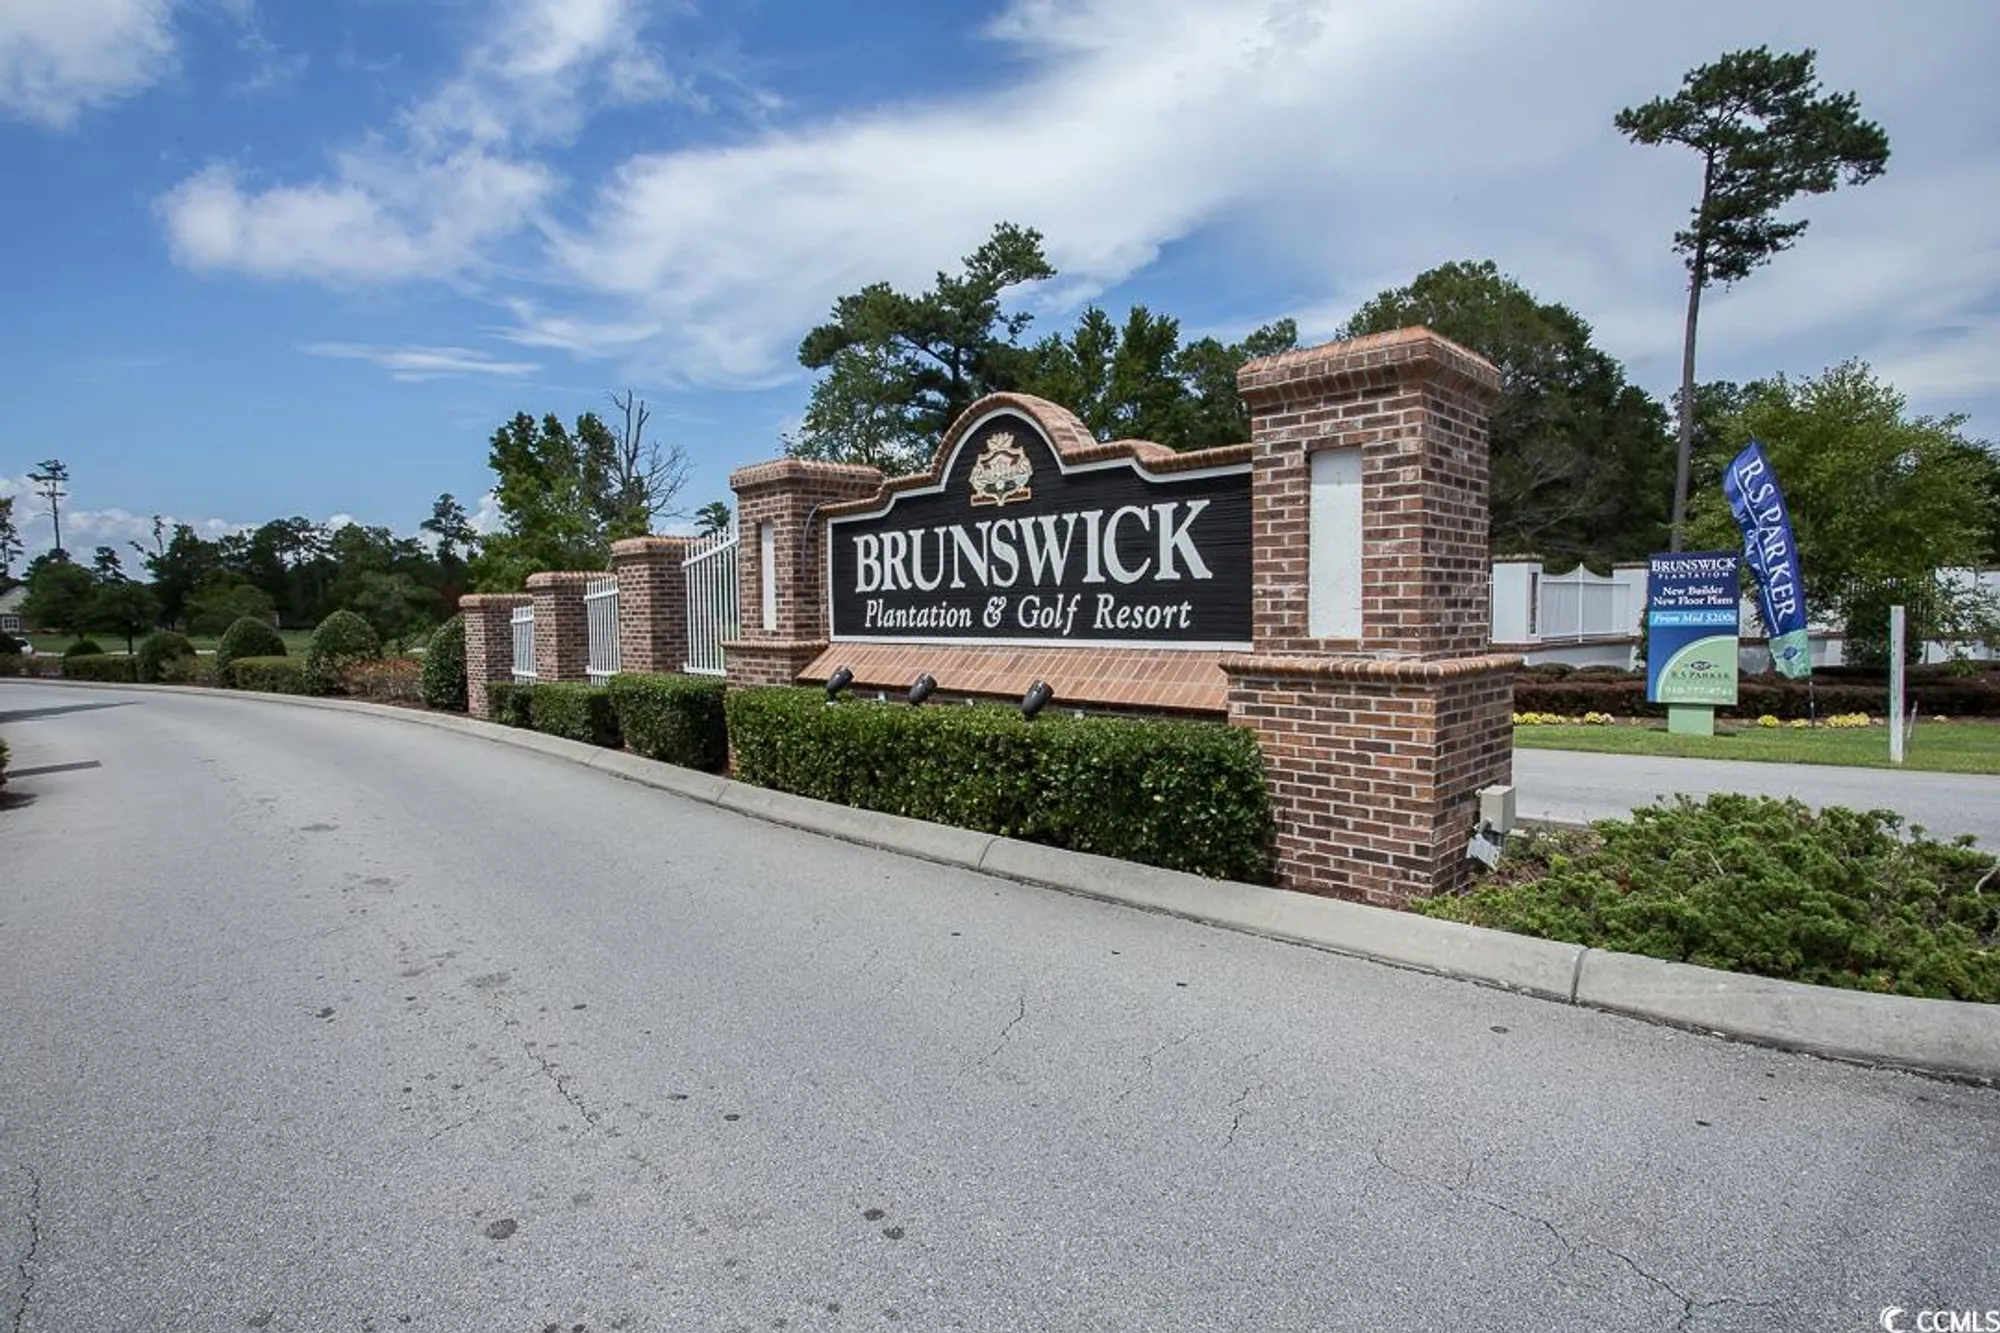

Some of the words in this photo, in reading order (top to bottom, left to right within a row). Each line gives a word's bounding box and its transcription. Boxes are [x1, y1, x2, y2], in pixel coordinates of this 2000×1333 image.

[852, 499, 1213, 593] BRUNSWICK
[1652, 557, 1737, 572] BRUNSWICK
[1759, 503, 1796, 622] PARKER
[1658, 571, 1729, 579] PLANTATION
[1663, 586, 1685, 596] New
[1688, 585, 1724, 596] Builder
[1653, 596, 1677, 606] New
[1678, 595, 1705, 605] Floor
[1707, 595, 1733, 605] Plans
[864, 599, 972, 629] Plantation
[983, 596, 1006, 630] &
[1017, 593, 1081, 637] Golf
[1093, 593, 1192, 630] Resort
[1654, 612, 1680, 623] From
[1681, 611, 1704, 622] Mid
